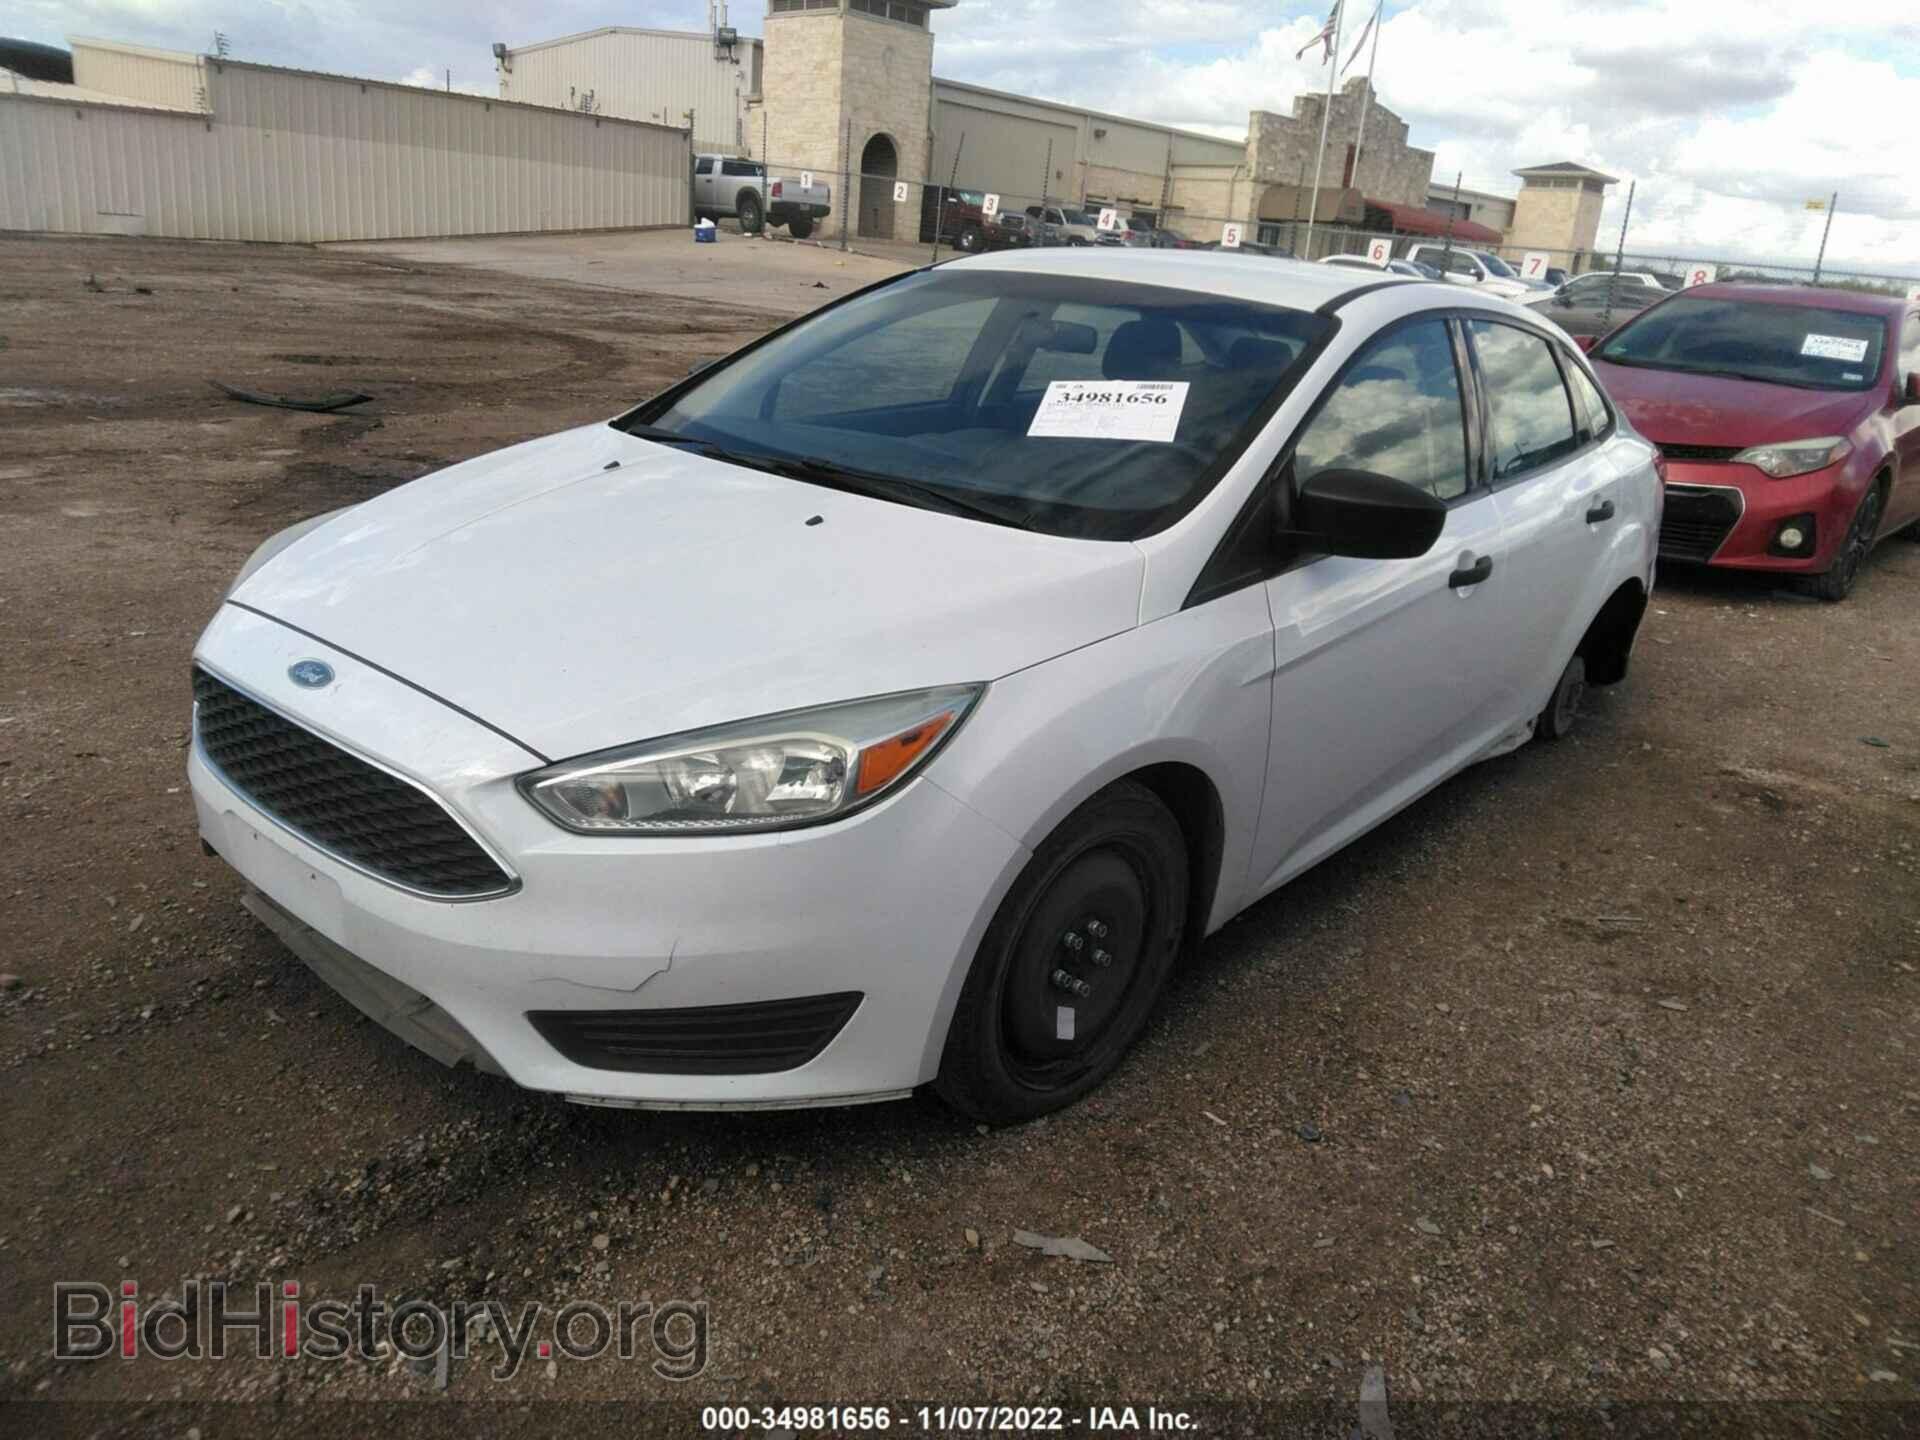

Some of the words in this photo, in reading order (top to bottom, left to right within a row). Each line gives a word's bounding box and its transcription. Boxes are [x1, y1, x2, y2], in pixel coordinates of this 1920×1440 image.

[801, 174, 810, 187] 1
[896, 186, 905, 199] 2
[986, 198, 995, 211] 3
[1100, 212, 1111, 227] 4
[1226, 228, 1236, 243] 5
[1373, 244, 1383, 260] 6
[1530, 258, 1542, 275] 7
[1692, 270, 1707, 285] 8
[1056, 391, 1168, 405] 34981656
